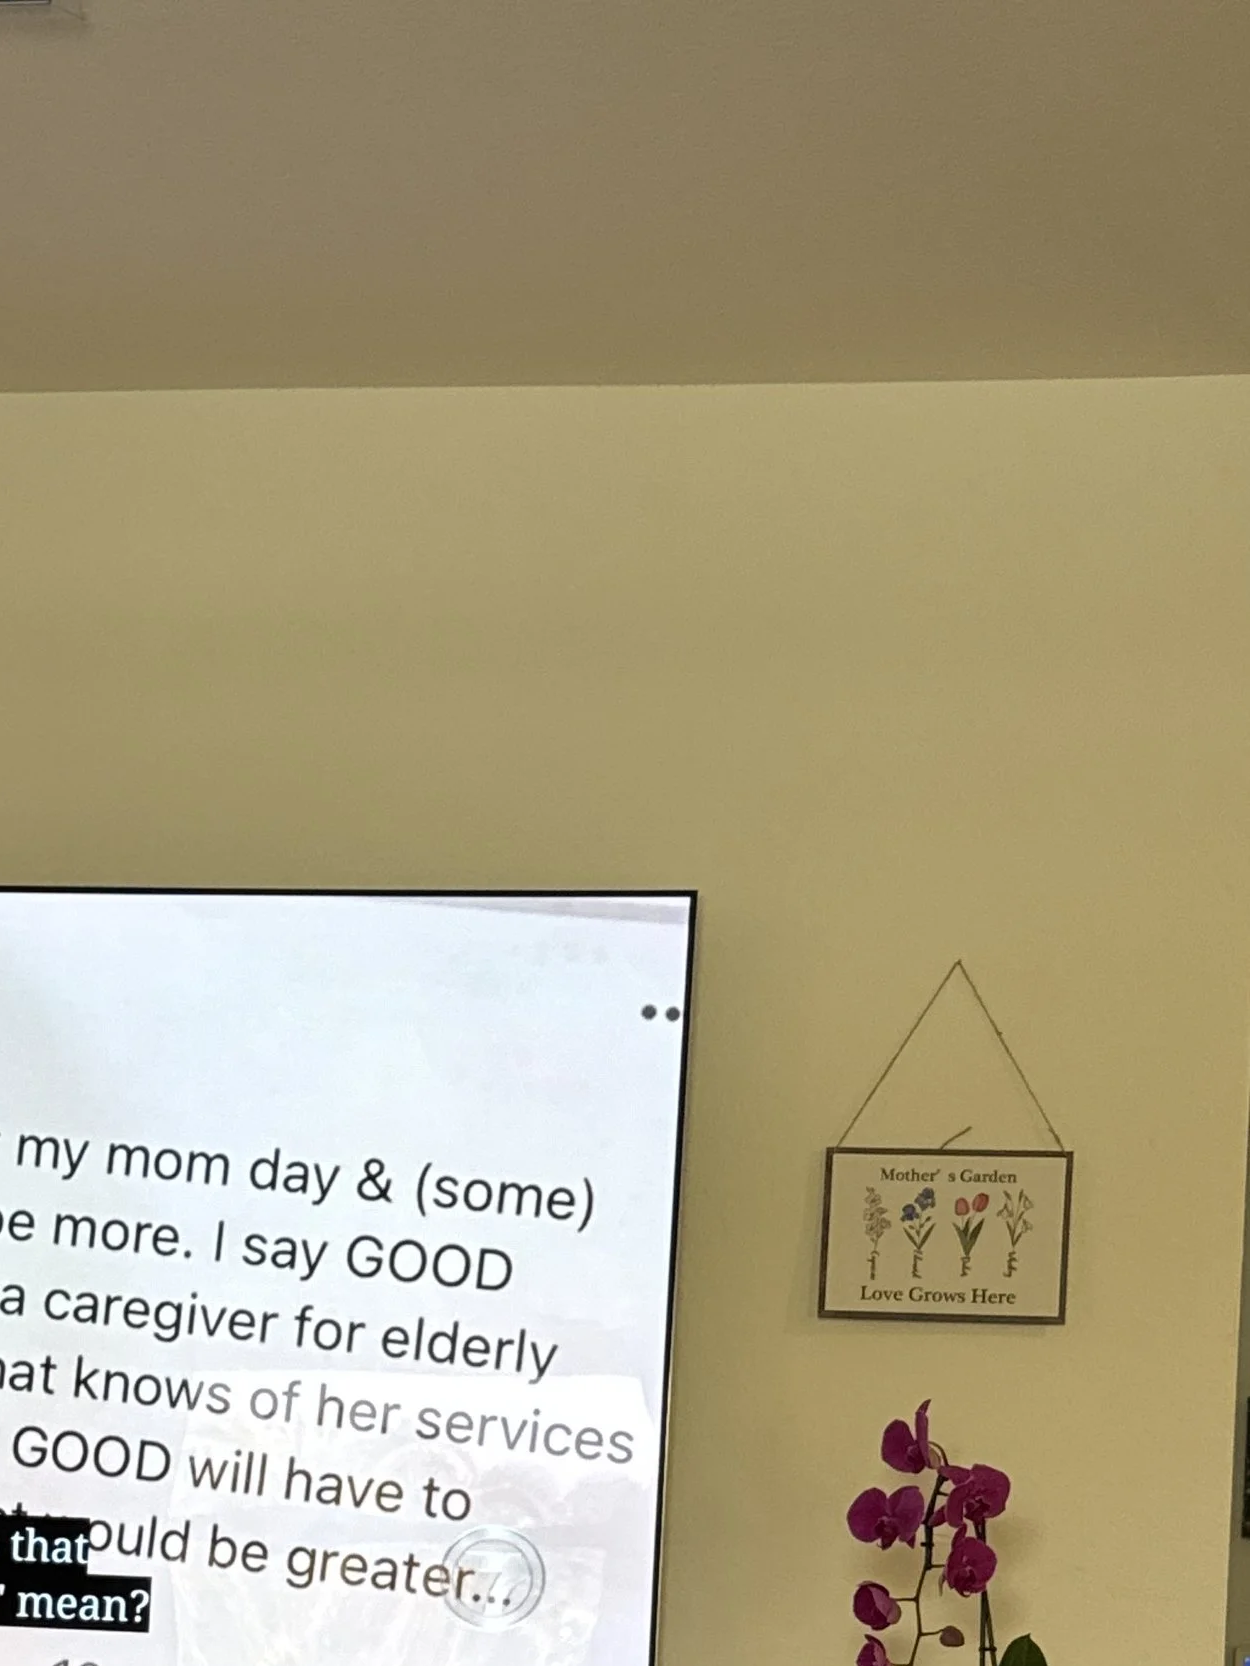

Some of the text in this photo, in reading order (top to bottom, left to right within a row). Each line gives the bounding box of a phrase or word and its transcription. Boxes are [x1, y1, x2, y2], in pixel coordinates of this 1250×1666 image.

[17, 1134, 90, 1180] my
[107, 1143, 229, 1186] mom
[250, 1148, 340, 1206] day
[357, 1158, 392, 1203] &
[417, 1162, 593, 1233] (some)
[959, 1169, 1017, 1184] Garden
[53, 1213, 191, 1259] more.
[215, 1220, 224, 1262] I
[242, 1234, 328, 1281] say
[347, 1235, 512, 1291] GOOD
[860, 1285, 1017, 1304] Love Grows Here
[0, 1284, 25, 1316] a
[44, 1289, 279, 1343] caregiver
[294, 1305, 366, 1353] for
[382, 1317, 558, 1384] elderly
[74, 1354, 230, 1414] knows
[250, 1380, 301, 1422] of
[317, 1383, 400, 1434] her
[416, 1408, 633, 1463] services
[13, 1426, 171, 1482] GOOD
[189, 1449, 267, 1496] will
[285, 1456, 403, 1512] have
[423, 1477, 471, 1521] to
[11, 1527, 90, 1564] that
[84, 1513, 190, 1563] ould
[208, 1523, 268, 1573] be
[286, 1540, 512, 1607] greater...
[16, 1588, 149, 1622] mean?
